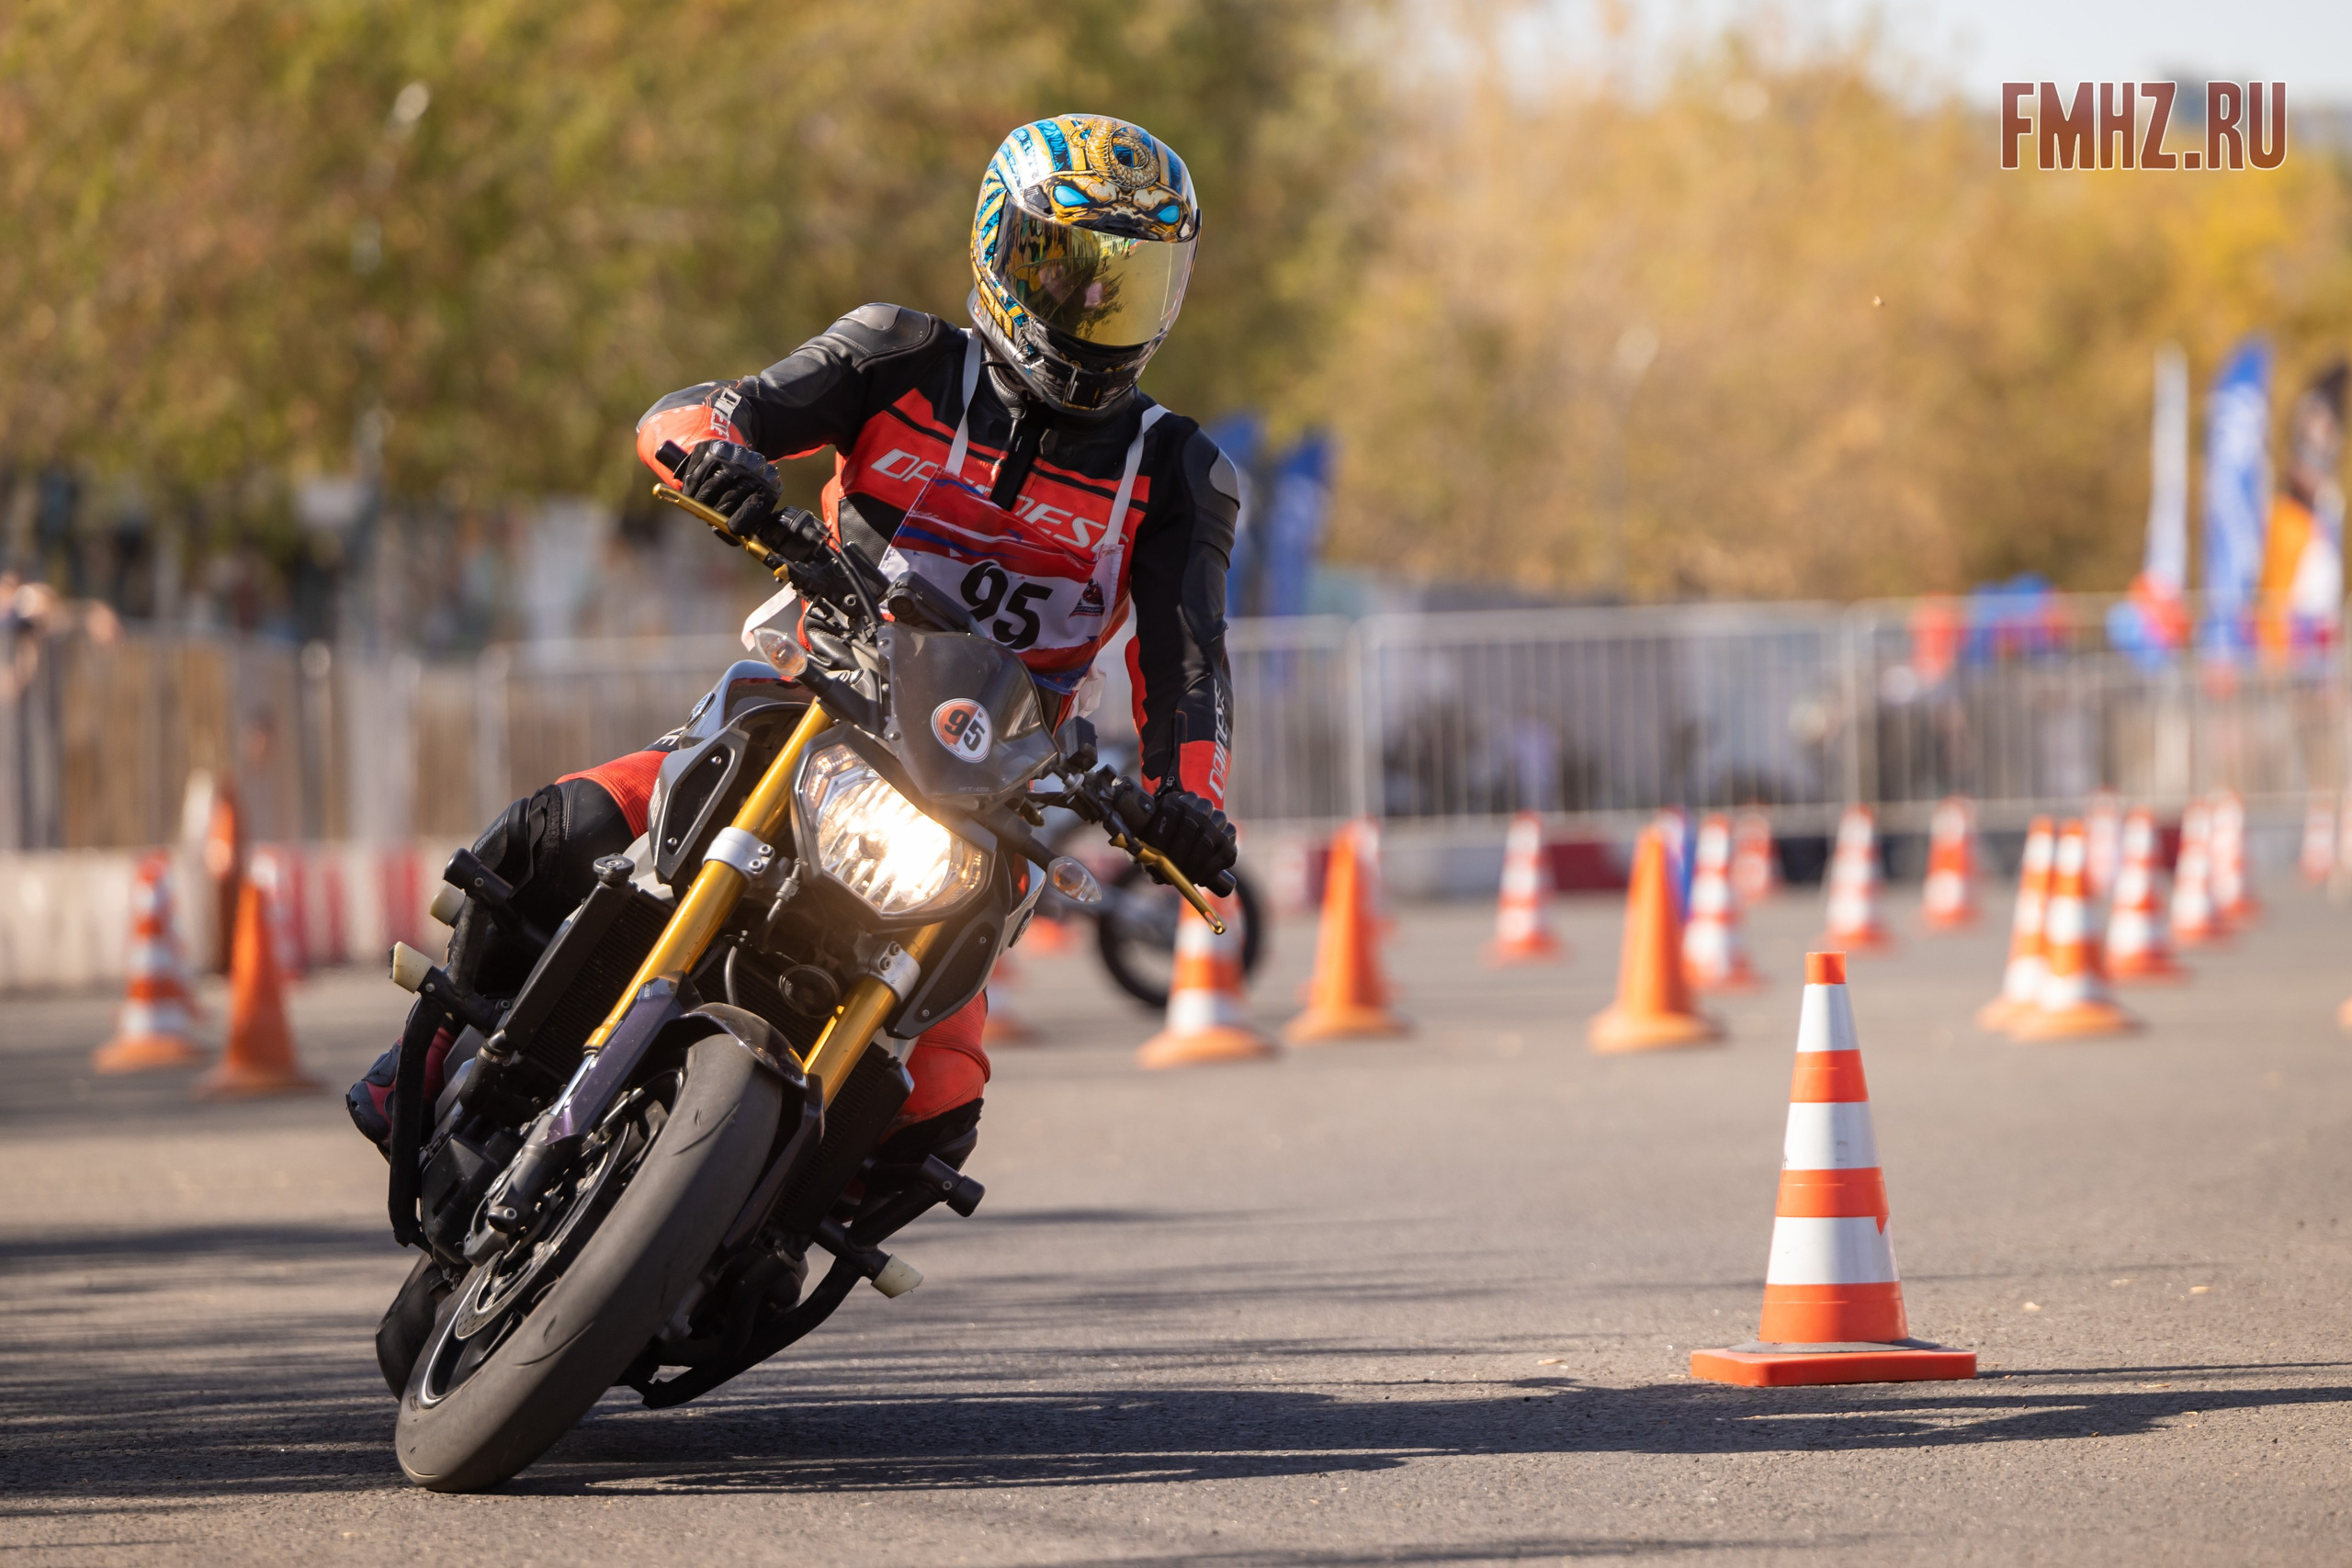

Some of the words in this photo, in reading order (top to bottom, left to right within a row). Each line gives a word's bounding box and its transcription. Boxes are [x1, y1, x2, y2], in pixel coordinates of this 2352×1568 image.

[870, 447, 1130, 555] DAES
[959, 559, 1054, 650] 95
[944, 708, 987, 751] 95
